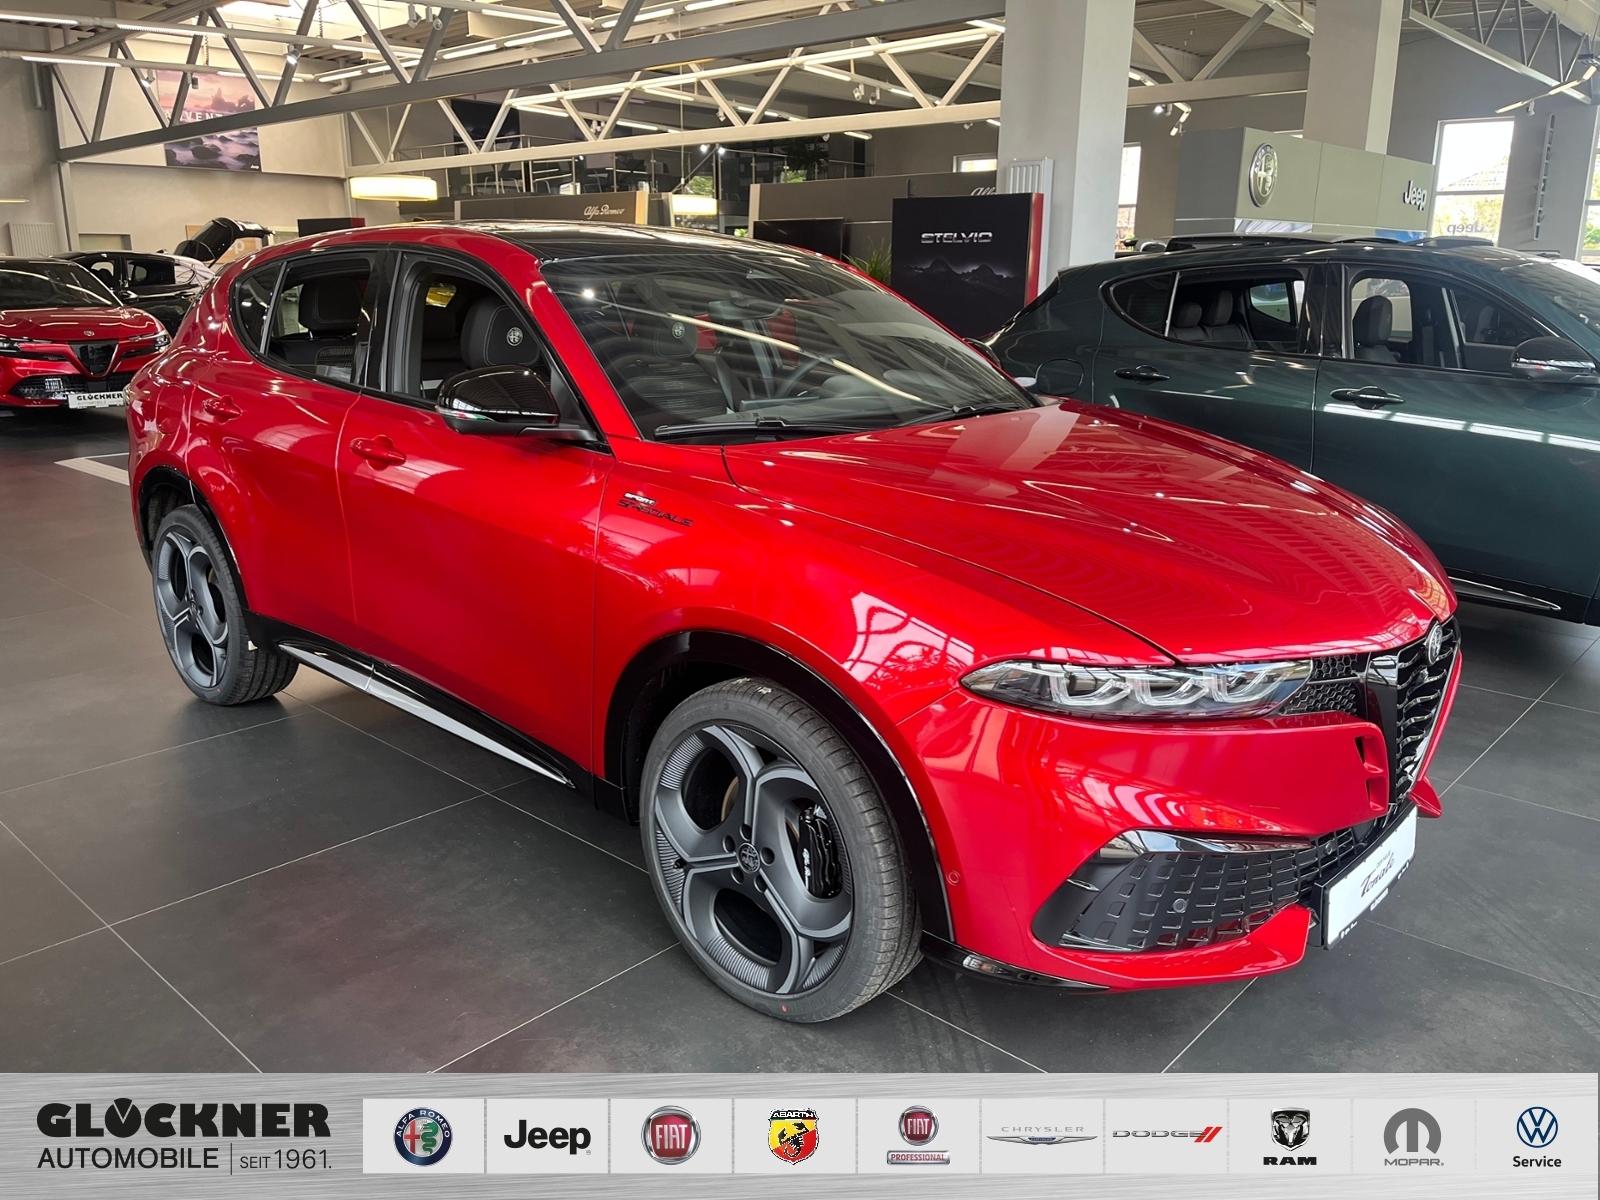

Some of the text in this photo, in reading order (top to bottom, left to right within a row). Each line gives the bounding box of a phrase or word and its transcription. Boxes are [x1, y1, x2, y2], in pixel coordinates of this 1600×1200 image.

[1403, 180, 1427, 210] Jeep
[584, 206, 600, 219] Alfa
[921, 232, 992, 243] STELVIO
